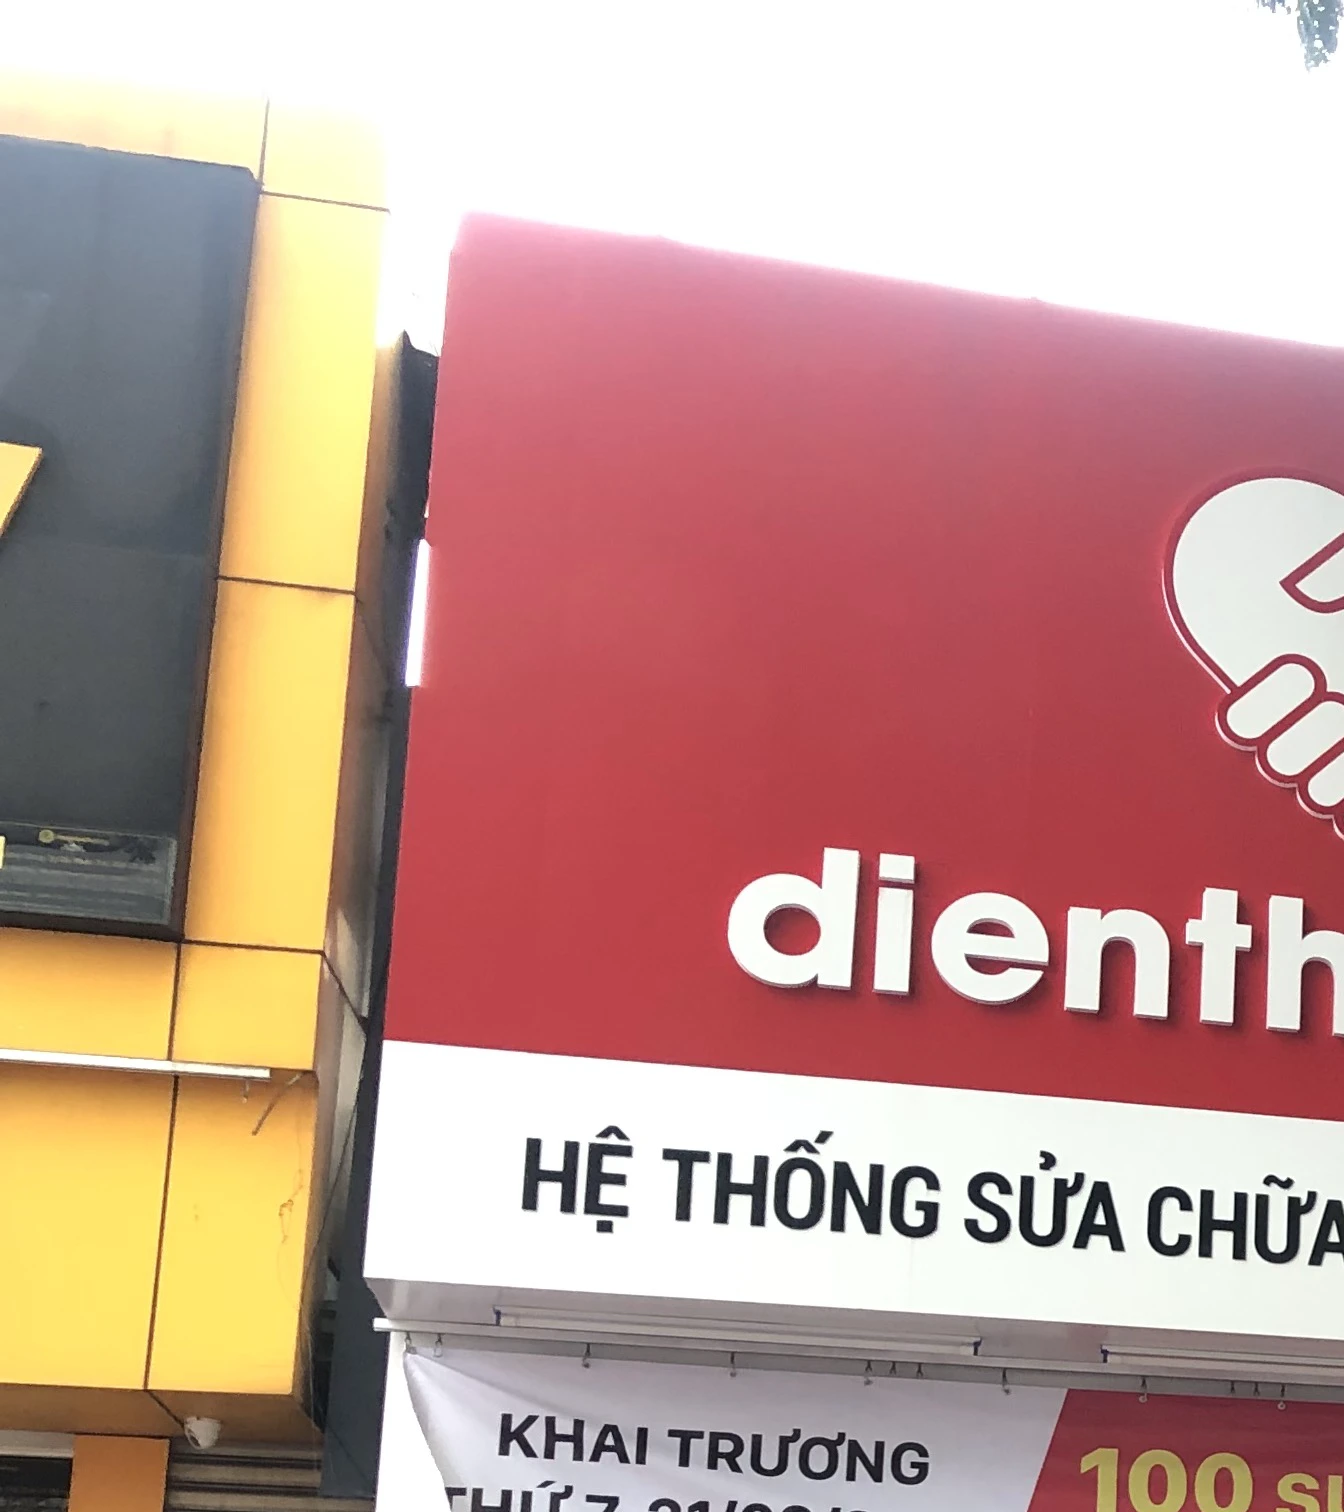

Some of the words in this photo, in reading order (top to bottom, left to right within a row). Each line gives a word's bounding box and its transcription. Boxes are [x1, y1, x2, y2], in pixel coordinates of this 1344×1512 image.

[521, 1124, 633, 1233] HỆ
[662, 1129, 940, 1238] THỐNG
[964, 1150, 1126, 1252] SỬA
[498, 1412, 648, 1466] KHAI
[668, 1427, 931, 1486] TRƯƠNG
